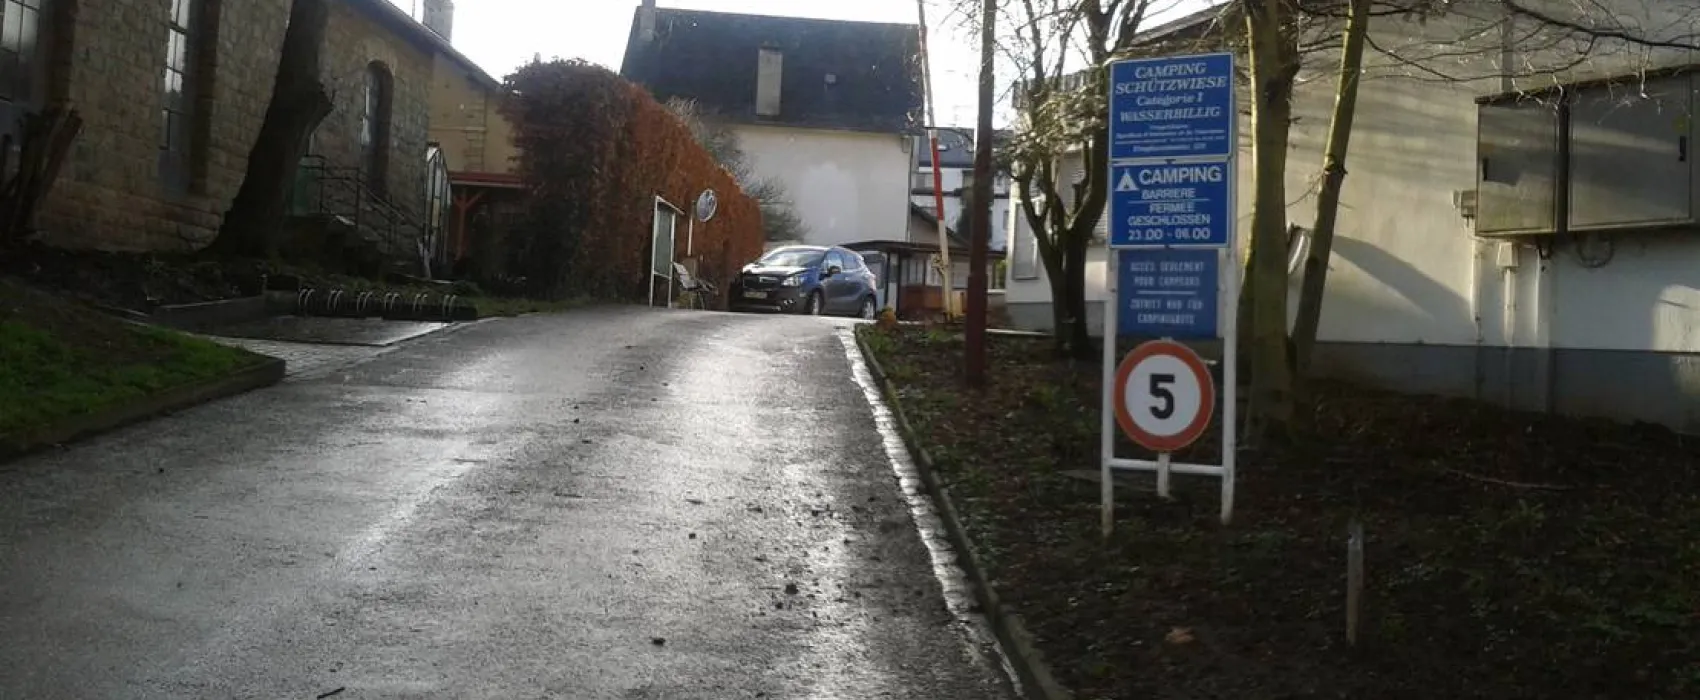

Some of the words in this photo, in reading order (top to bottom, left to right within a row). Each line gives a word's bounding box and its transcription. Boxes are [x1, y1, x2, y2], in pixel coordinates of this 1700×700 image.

[1135, 62, 1207, 79] CAMPING
[1115, 75, 1227, 95] SCHÜTZWIESE
[1120, 106, 1221, 122] WASSERBILLIG
[1138, 165, 1222, 185] CAMPING
[1127, 213, 1211, 226] GESCHLOSSEN
[1149, 373, 1175, 420] 5
